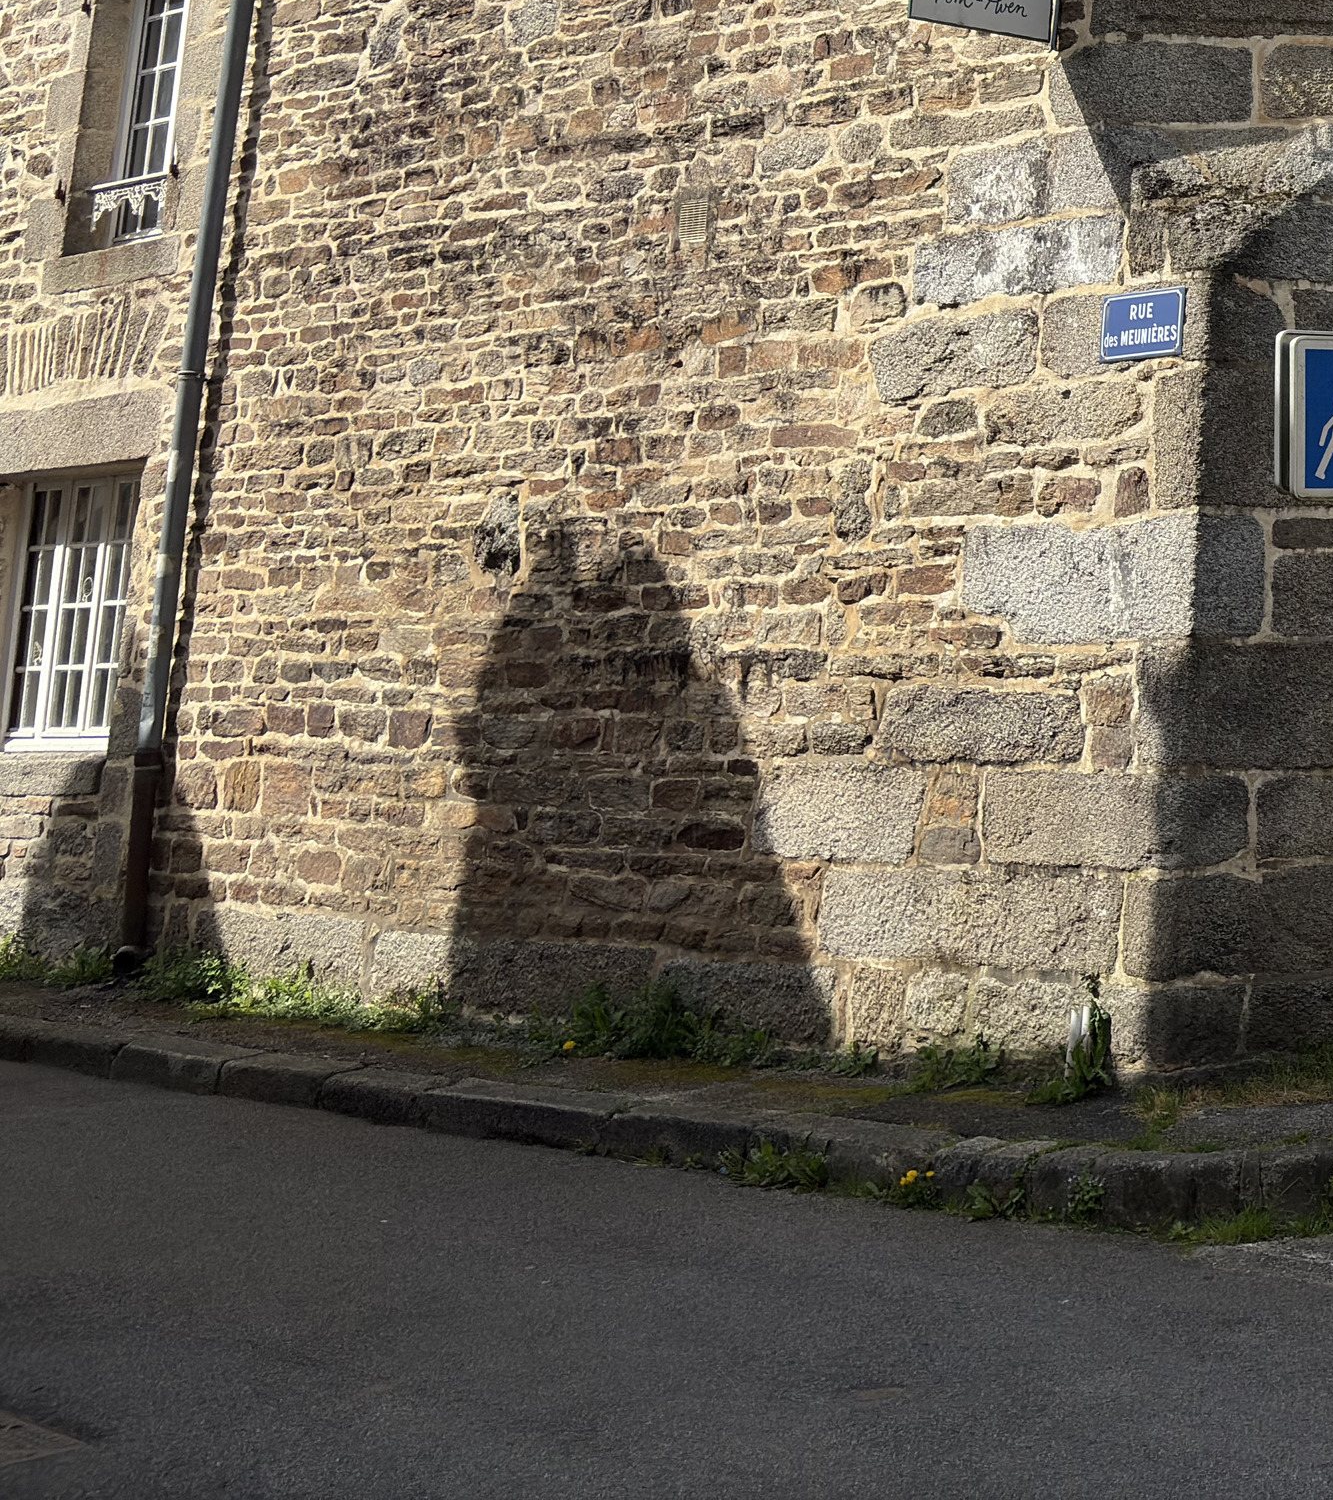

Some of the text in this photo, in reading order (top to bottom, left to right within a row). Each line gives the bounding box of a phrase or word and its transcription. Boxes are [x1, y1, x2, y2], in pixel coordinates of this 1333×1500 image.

[1129, 302, 1154, 321] RUE
[1103, 322, 1178, 348] des MEUNIÈRES
